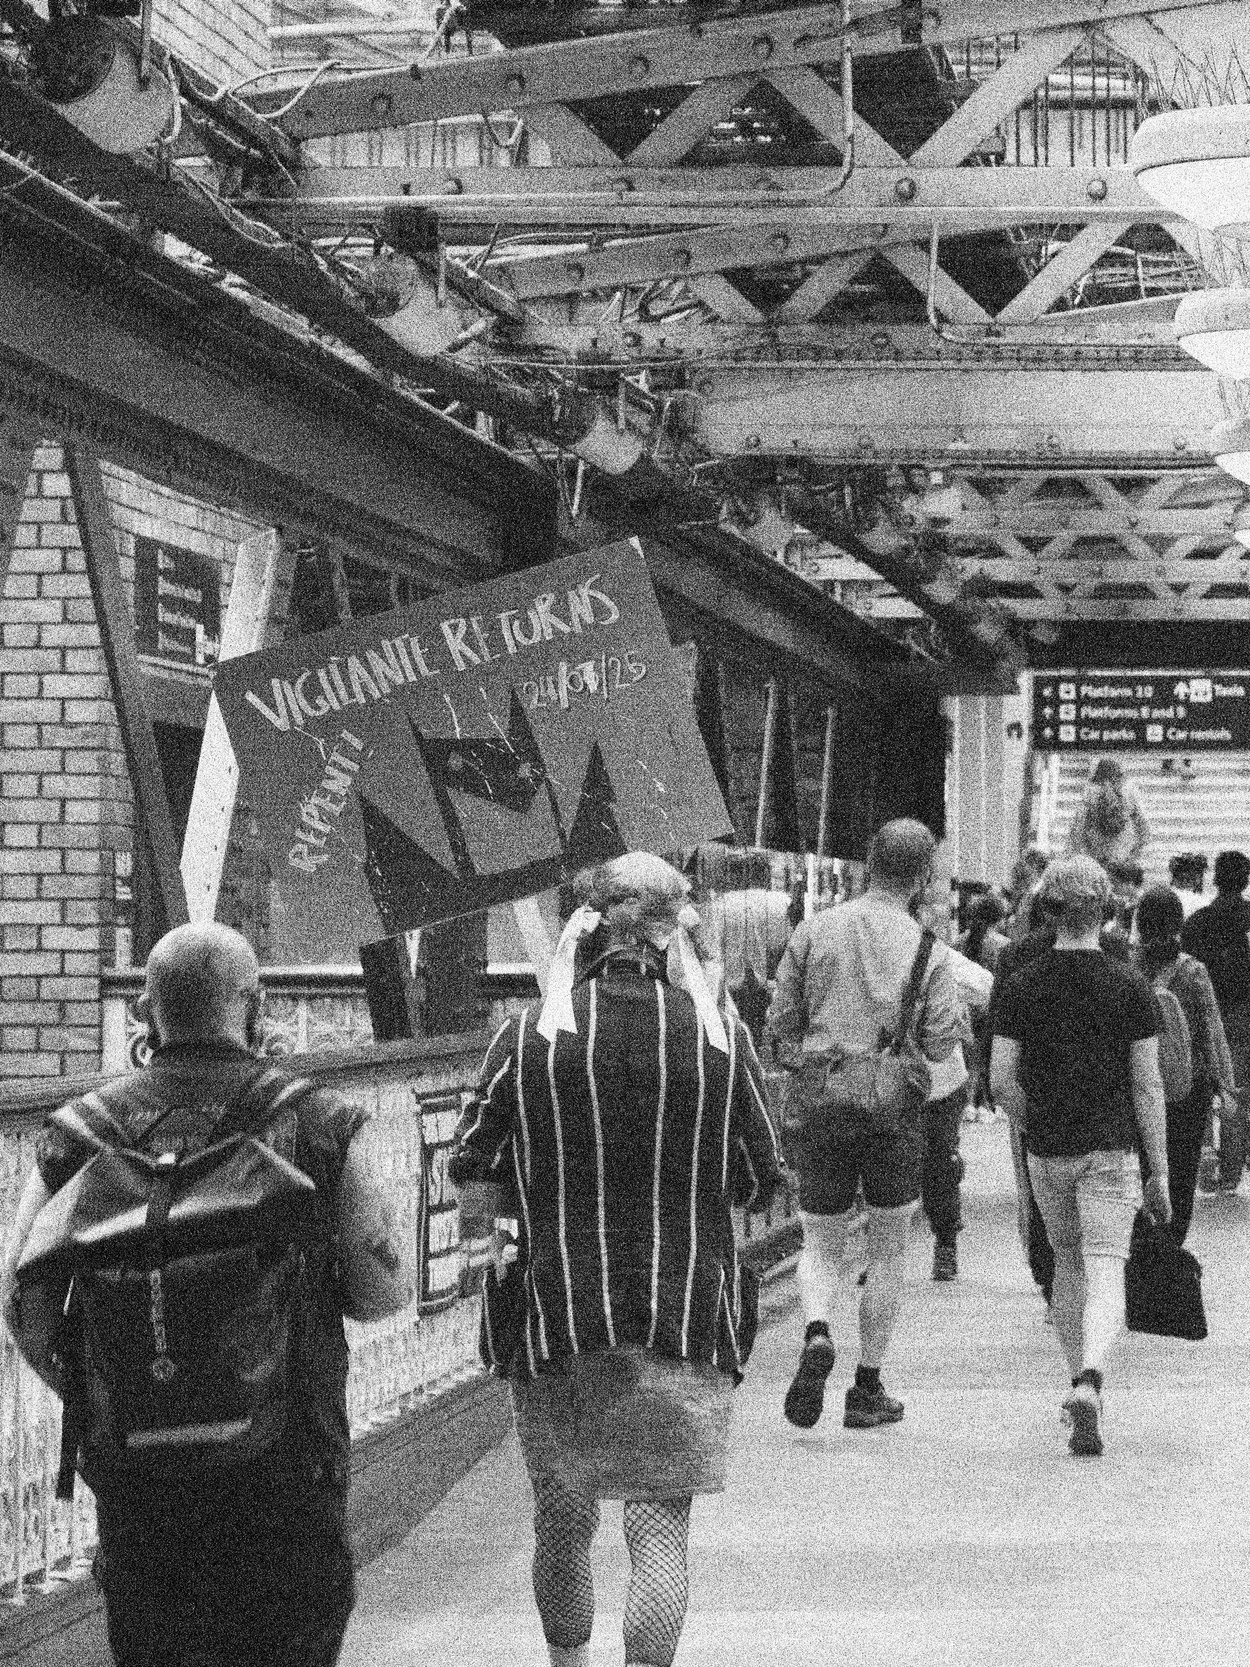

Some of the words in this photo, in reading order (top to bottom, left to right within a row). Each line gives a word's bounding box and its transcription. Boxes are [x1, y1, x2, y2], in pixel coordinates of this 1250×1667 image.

[245, 633, 441, 732] VIGILANTE
[440, 574, 620, 672] RETURNS
[1080, 685, 1133, 698] Platform
[1135, 685, 1153, 698] 10
[1213, 683, 1245, 697] Taxis
[1080, 706, 1139, 719] Platforms
[1152, 706, 1175, 719] and
[1080, 728, 1100, 740] Car
[1102, 728, 1136, 742] parks
[1167, 727, 1188, 740] Car
